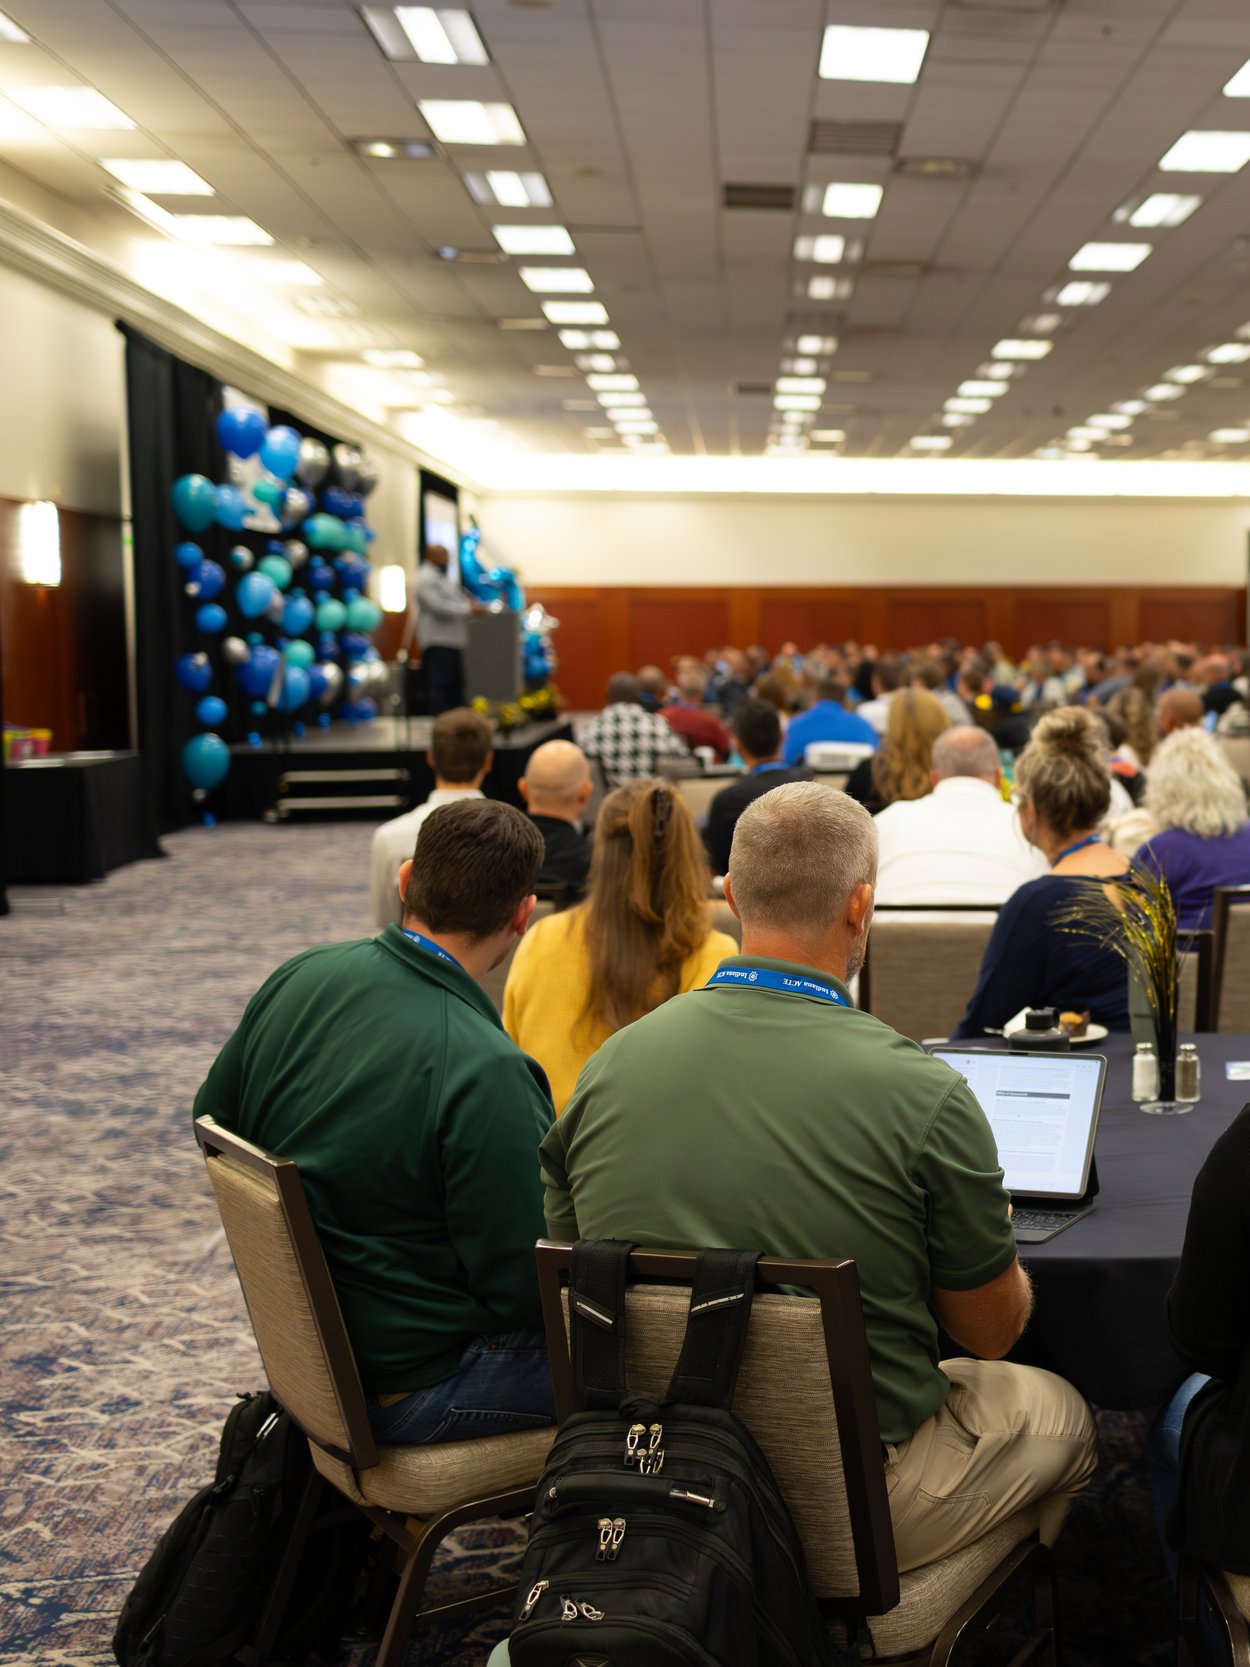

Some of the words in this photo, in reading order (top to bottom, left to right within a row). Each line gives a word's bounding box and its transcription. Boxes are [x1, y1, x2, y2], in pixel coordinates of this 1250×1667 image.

[726, 971, 748, 979] Indiana
[783, 978, 802, 987] ACTE
[803, 981, 829, 994] Indiana
